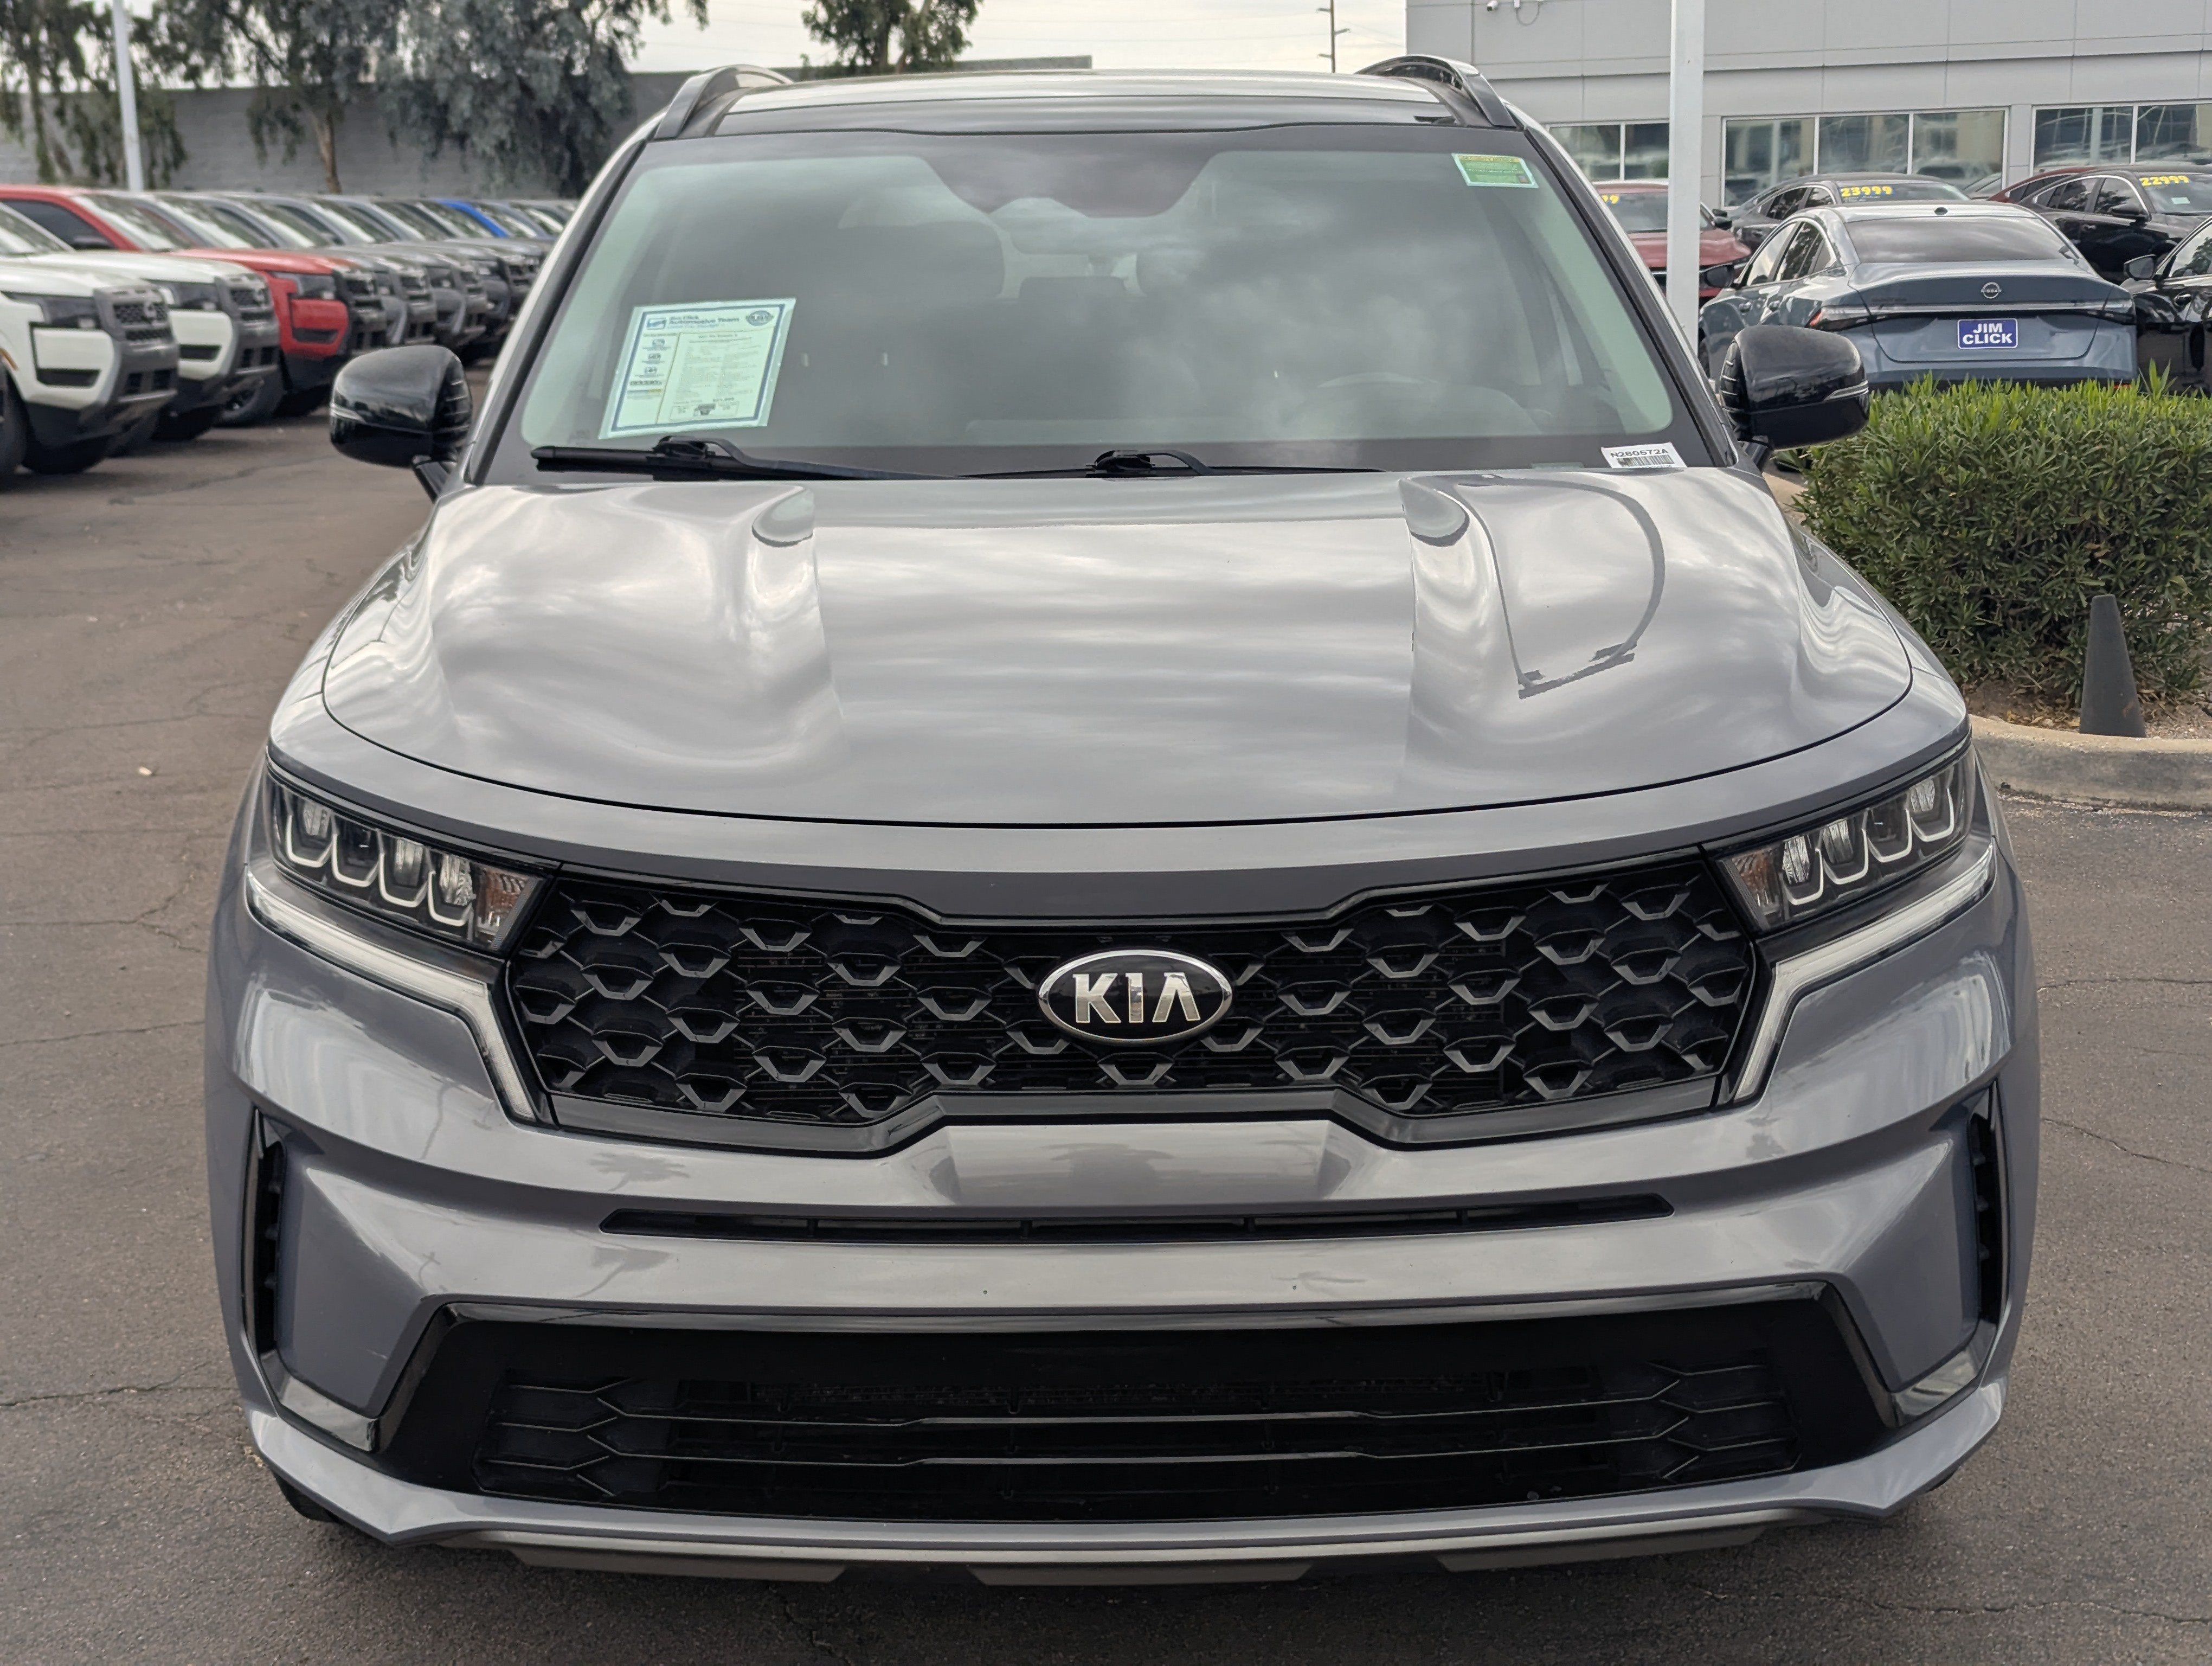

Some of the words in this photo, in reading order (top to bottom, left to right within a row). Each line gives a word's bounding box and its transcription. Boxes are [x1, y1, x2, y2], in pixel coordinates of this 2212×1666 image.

[2139, 175, 2190, 186] 22999
[1840, 185, 1892, 197] 23999
[1972, 323, 2003, 334] JIM
[1963, 333, 2012, 344] CLICK
[1072, 972, 1201, 1023] KIA
